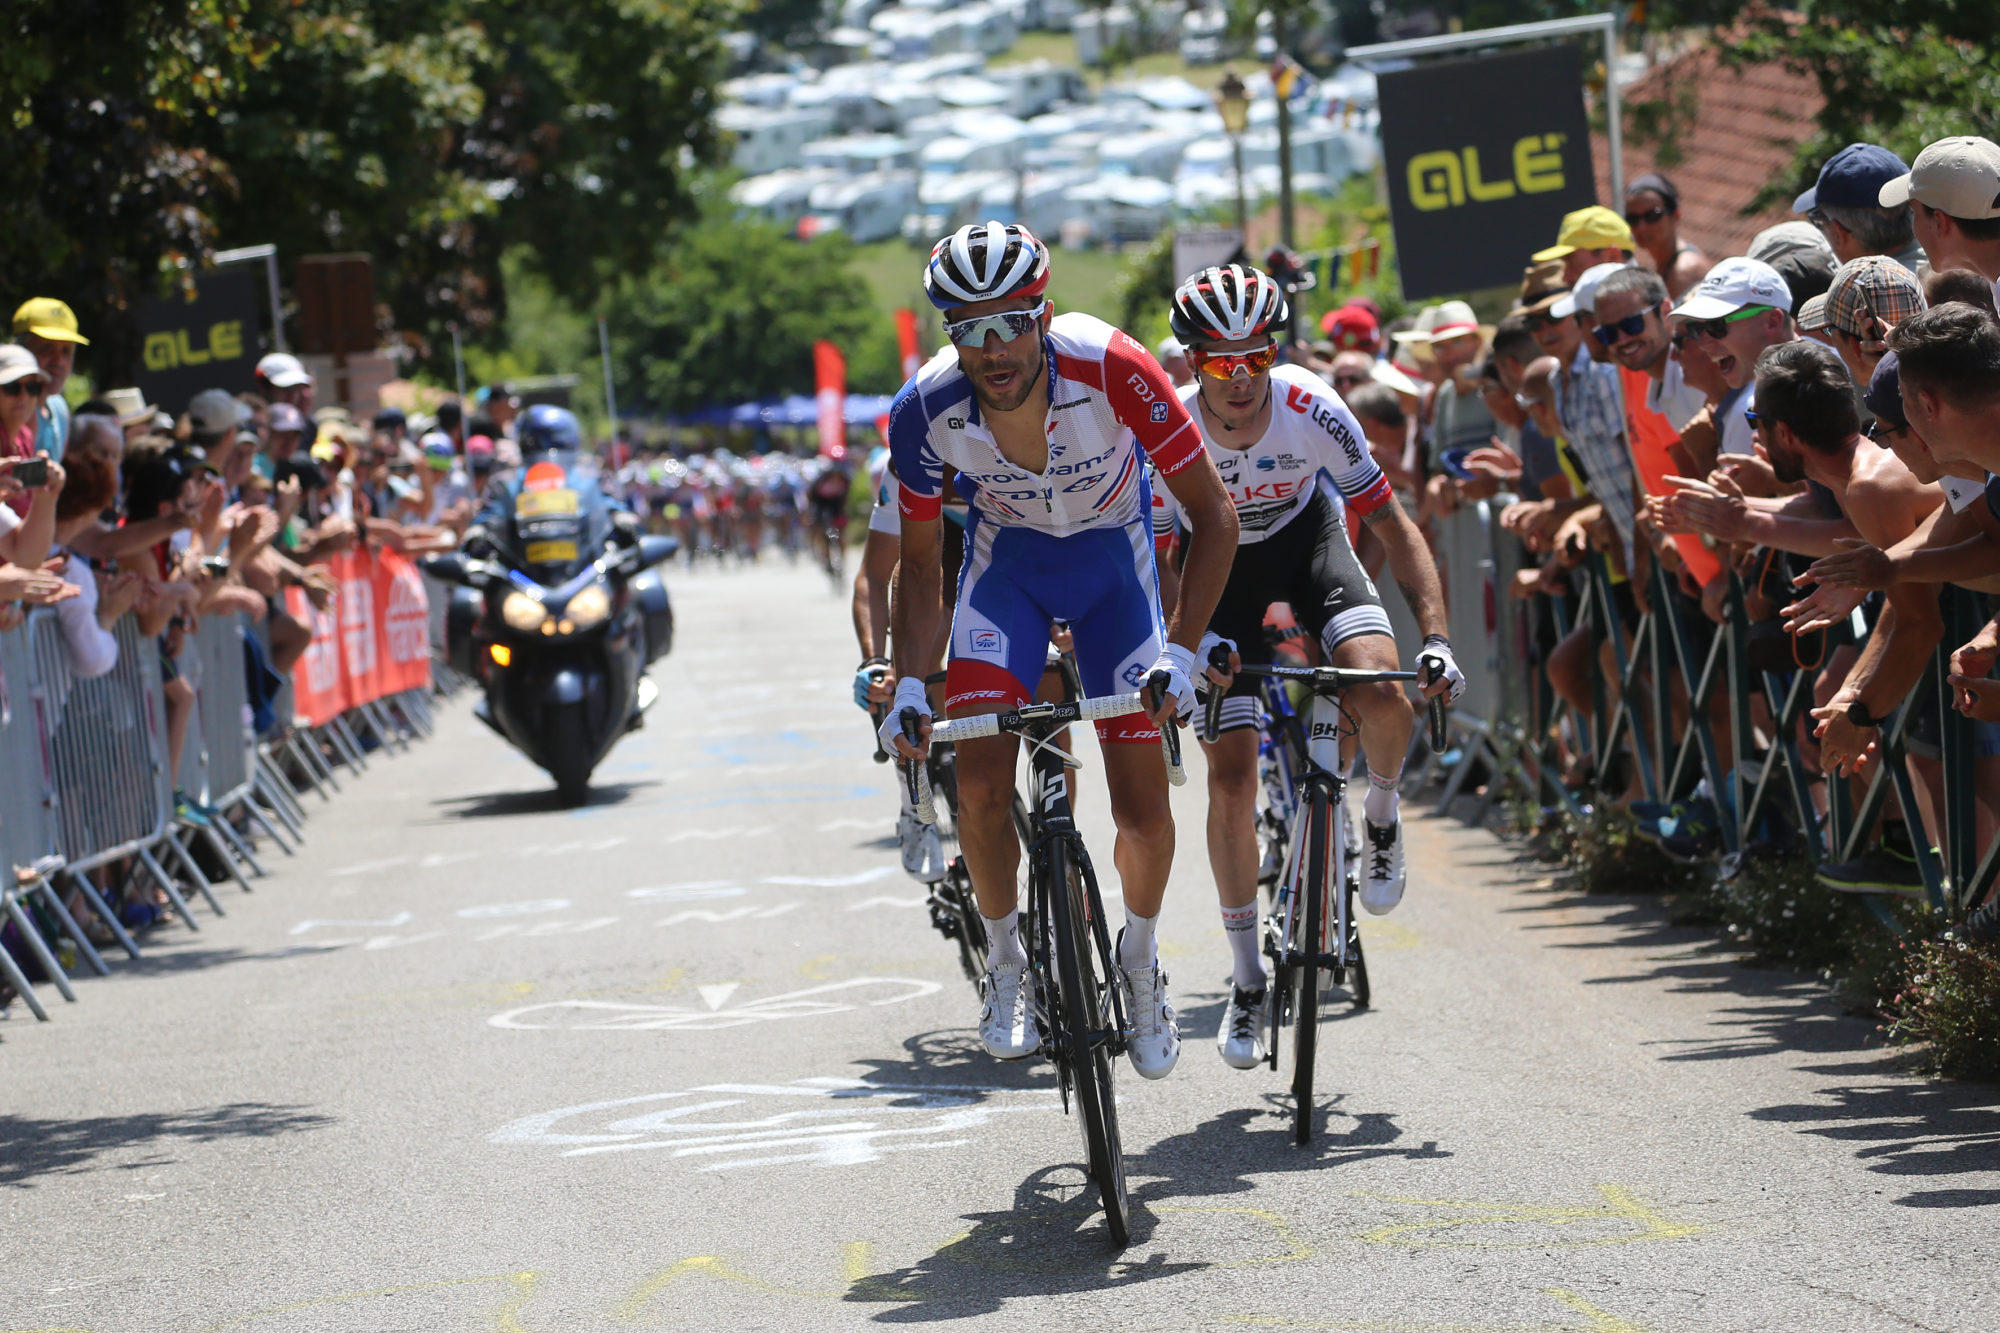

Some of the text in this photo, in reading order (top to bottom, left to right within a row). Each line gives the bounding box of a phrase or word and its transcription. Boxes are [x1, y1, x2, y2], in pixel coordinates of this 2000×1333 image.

[1127, 372, 1156, 402] FDJ
[1312, 404, 1363, 466] LEGENDRE
[945, 690, 1006, 707] ERRE
[1027, 702, 1046, 713] GARMIN
[1053, 706, 1075, 719] PRO
[1003, 715, 1021, 727] PR
[1118, 730, 1162, 739] LAP
[1313, 722, 1338, 737] BH
